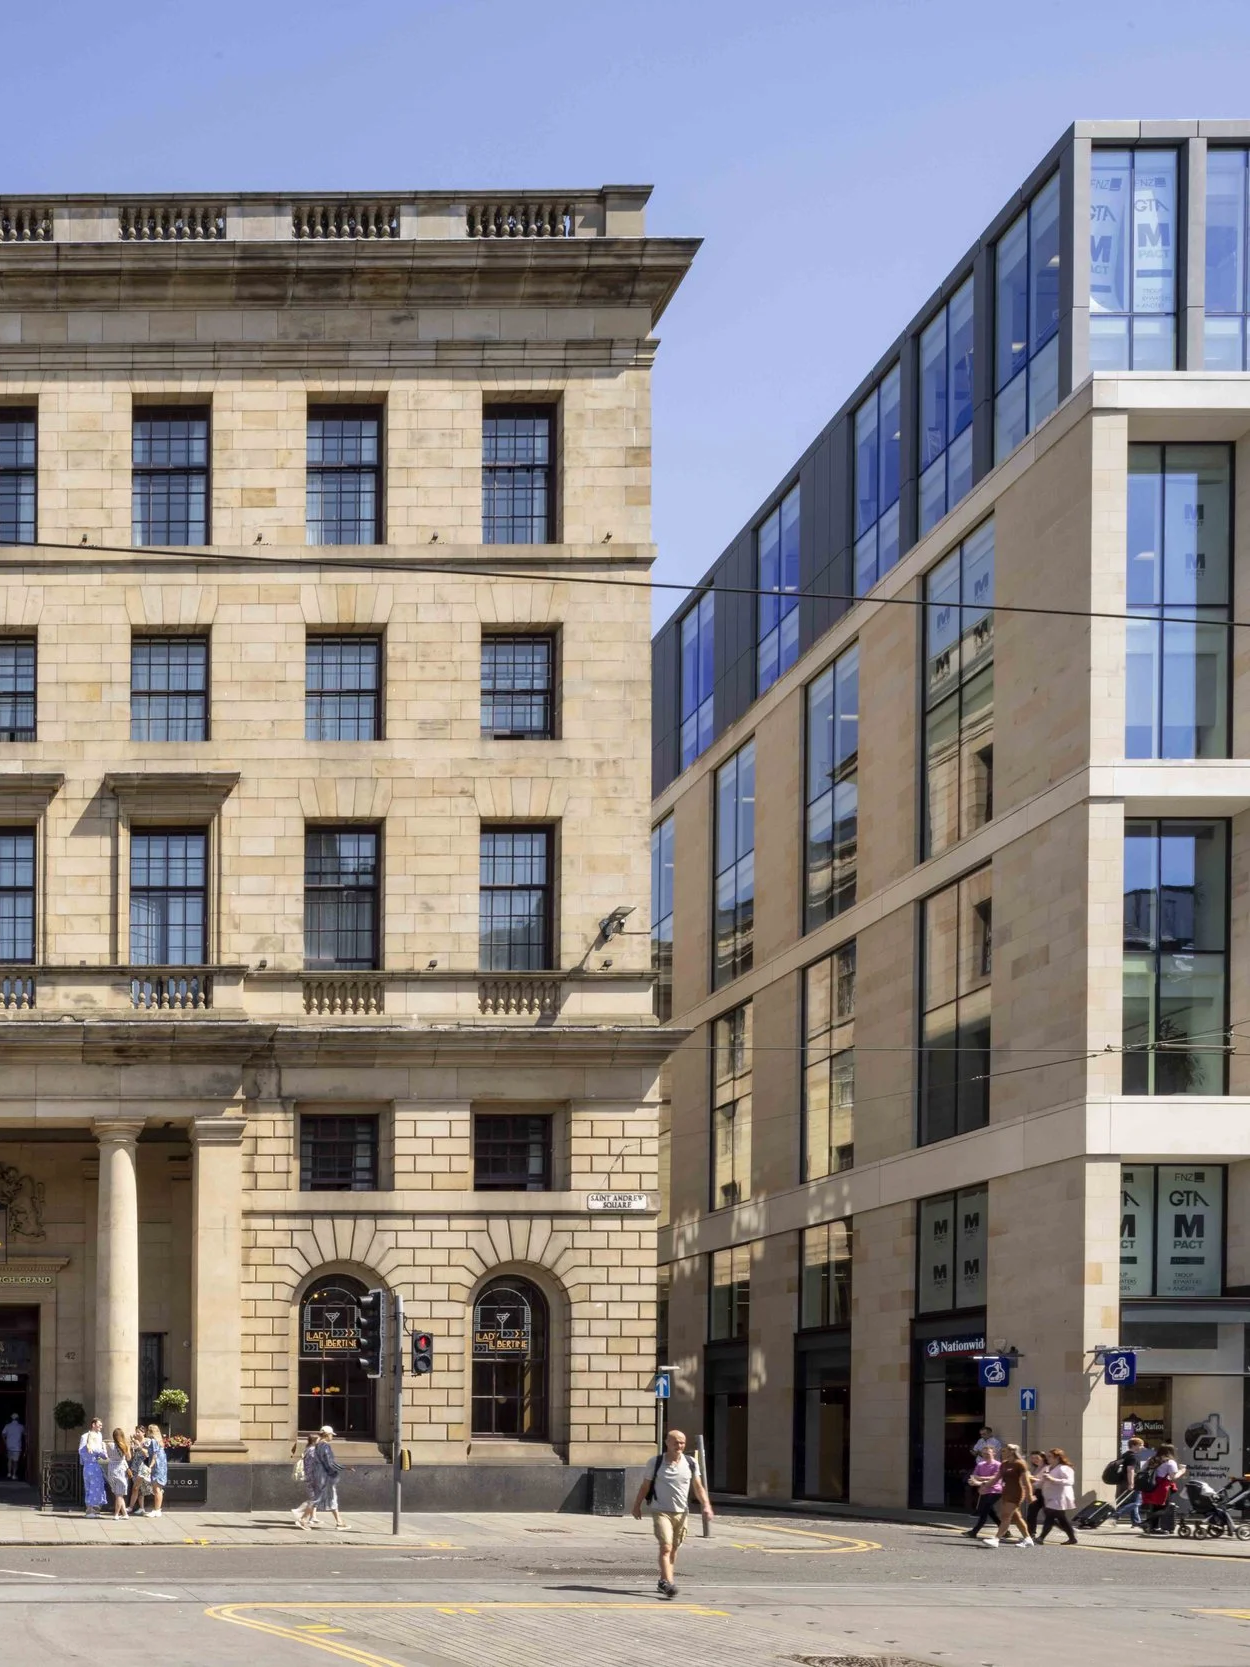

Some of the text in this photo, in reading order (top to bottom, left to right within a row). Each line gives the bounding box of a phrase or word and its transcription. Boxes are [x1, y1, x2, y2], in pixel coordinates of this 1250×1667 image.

[1135, 199, 1169, 212] GTA
[1138, 223, 1170, 247] M
[1138, 249, 1169, 258] PACT
[1184, 504, 1204, 519] M
[1186, 553, 1205, 569] M
[1175, 1173, 1193, 1181] FNZ
[1169, 1191, 1210, 1206] GTA
[934, 1219, 948, 1235] M
[964, 1212, 979, 1229] M
[1174, 1214, 1204, 1238] M
[1121, 1241, 1135, 1249] CT
[1174, 1241, 1204, 1249] PACT
[933, 1265, 947, 1280] M
[964, 1258, 979, 1275] M
[19, 1276, 51, 1284] GRAND
[306, 1332, 330, 1341] LADY
[320, 1339, 357, 1348] LIBERTINE
[489, 1340, 528, 1349] LBERTINE
[941, 1338, 985, 1352] Nationwid
